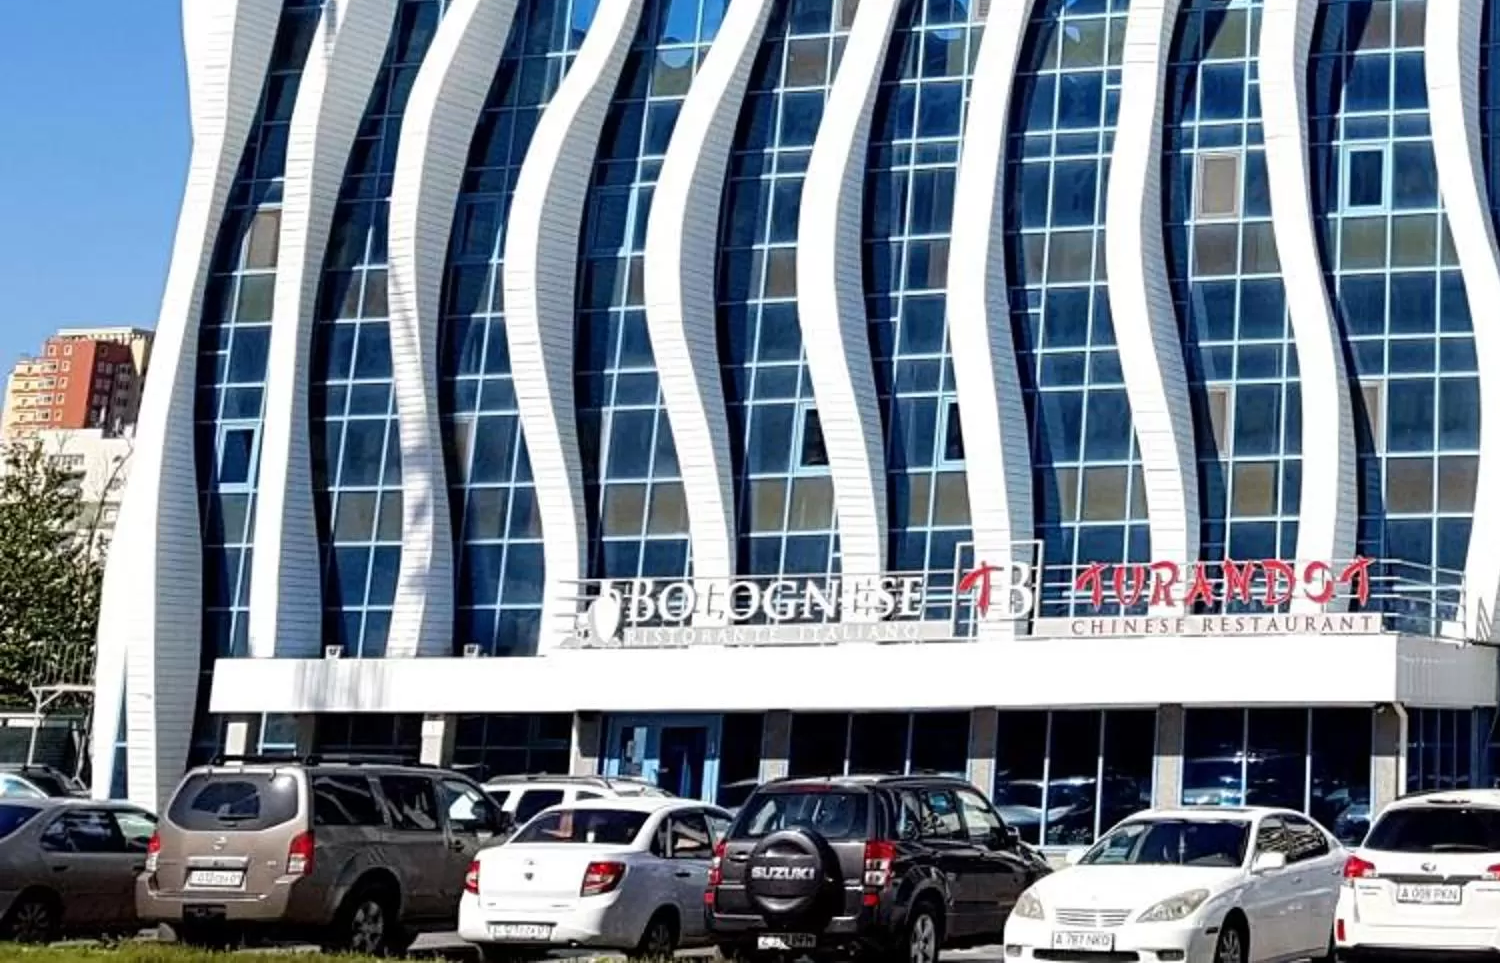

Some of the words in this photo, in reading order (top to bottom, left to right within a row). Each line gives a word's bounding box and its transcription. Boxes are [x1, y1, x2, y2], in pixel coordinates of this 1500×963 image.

[1076, 555, 1377, 608] TURANDOT
[624, 576, 923, 622] BOLOGNESE
[624, 626, 779, 646] RISTORANTE
[799, 623, 919, 642] ITALIANO
[1071, 617, 1187, 635] CHINESE
[1201, 614, 1378, 634] RESTAURANT
[751, 866, 815, 880] SUZUKI
